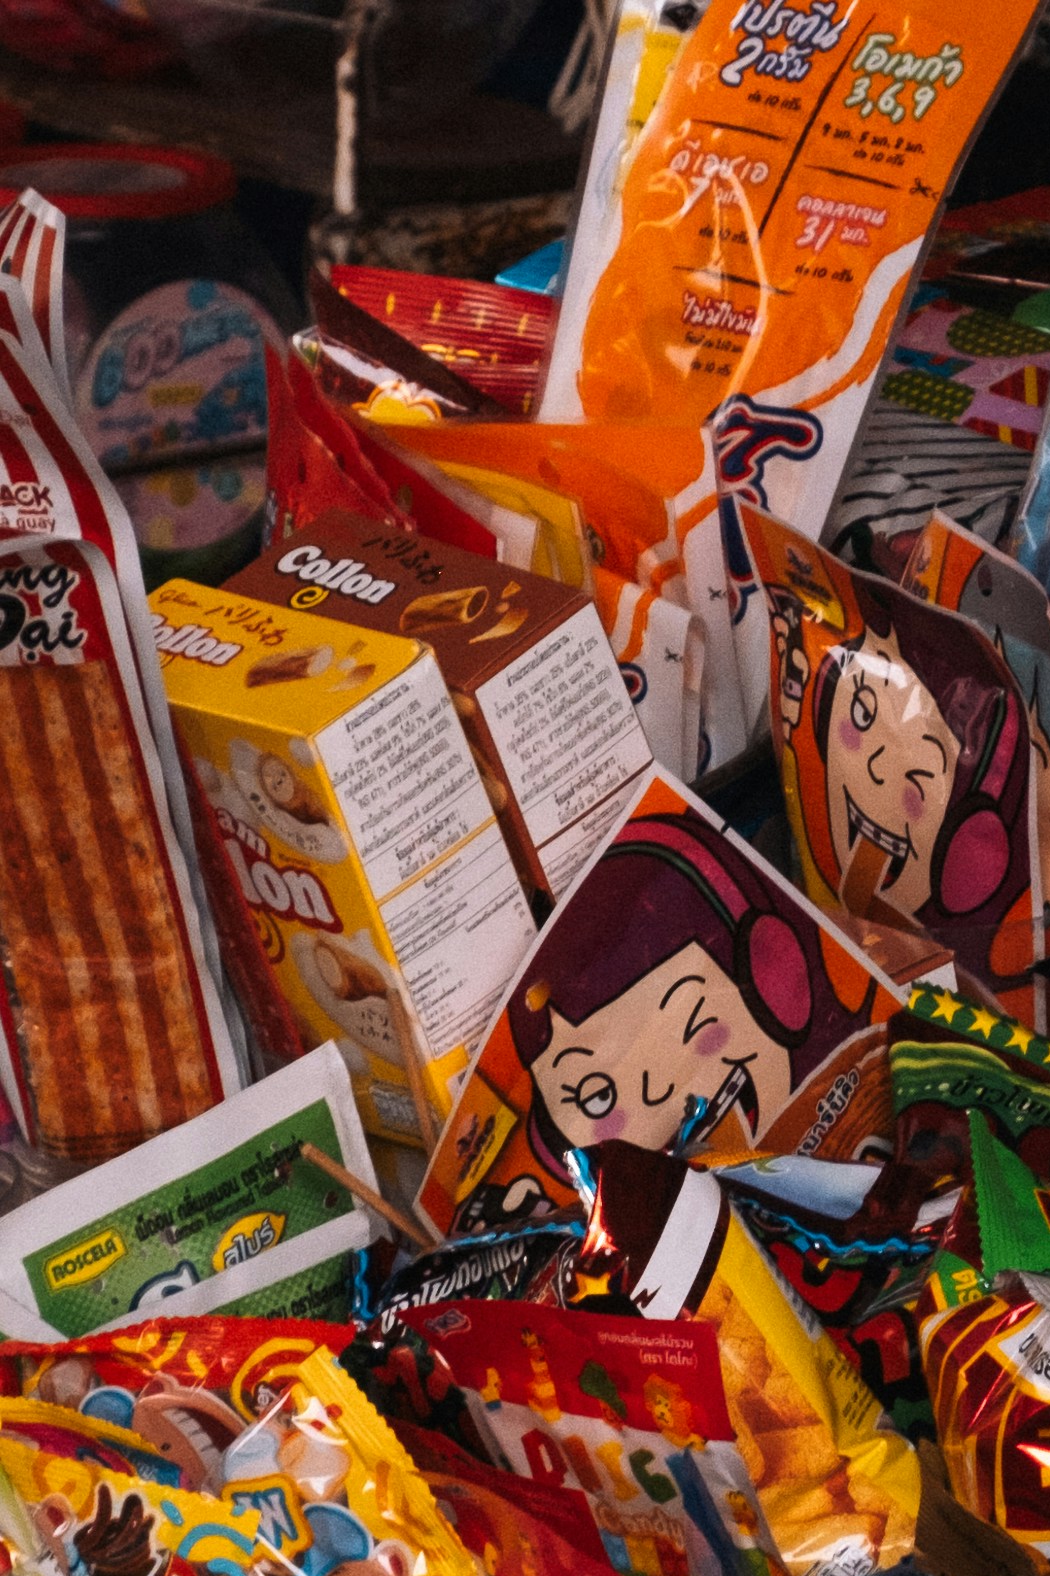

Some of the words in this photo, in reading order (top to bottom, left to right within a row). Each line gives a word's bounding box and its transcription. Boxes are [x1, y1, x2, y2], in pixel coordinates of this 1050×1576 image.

[720, 36, 765, 86] 2
[852, 33, 963, 87] โอเมก้า
[844, 76, 936, 123] 3,6,9
[0, 485, 54, 508] ACK
[0, 562, 76, 608] ng
[276, 544, 397, 605] Collon
[798, 1067, 861, 1156] บาร์บีคิว
